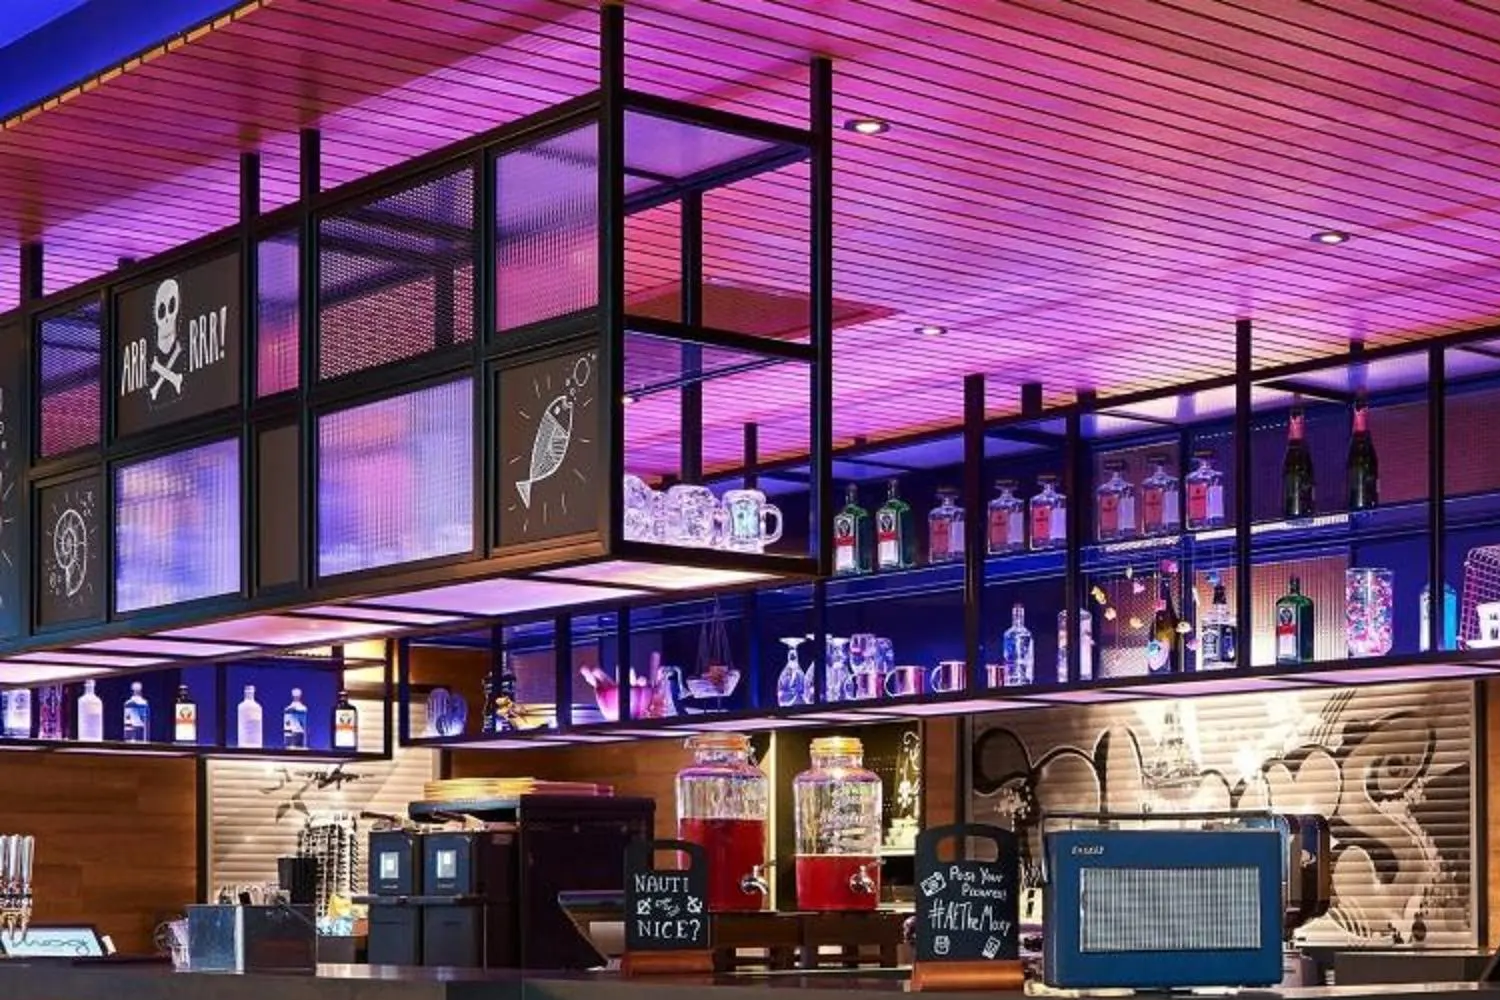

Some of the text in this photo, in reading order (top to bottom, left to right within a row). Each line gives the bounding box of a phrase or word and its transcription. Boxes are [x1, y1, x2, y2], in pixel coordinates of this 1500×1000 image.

[121, 305, 227, 397] ARR RRR!
[634, 873, 689, 893] NAUTI
[637, 918, 701, 941] NICE?
